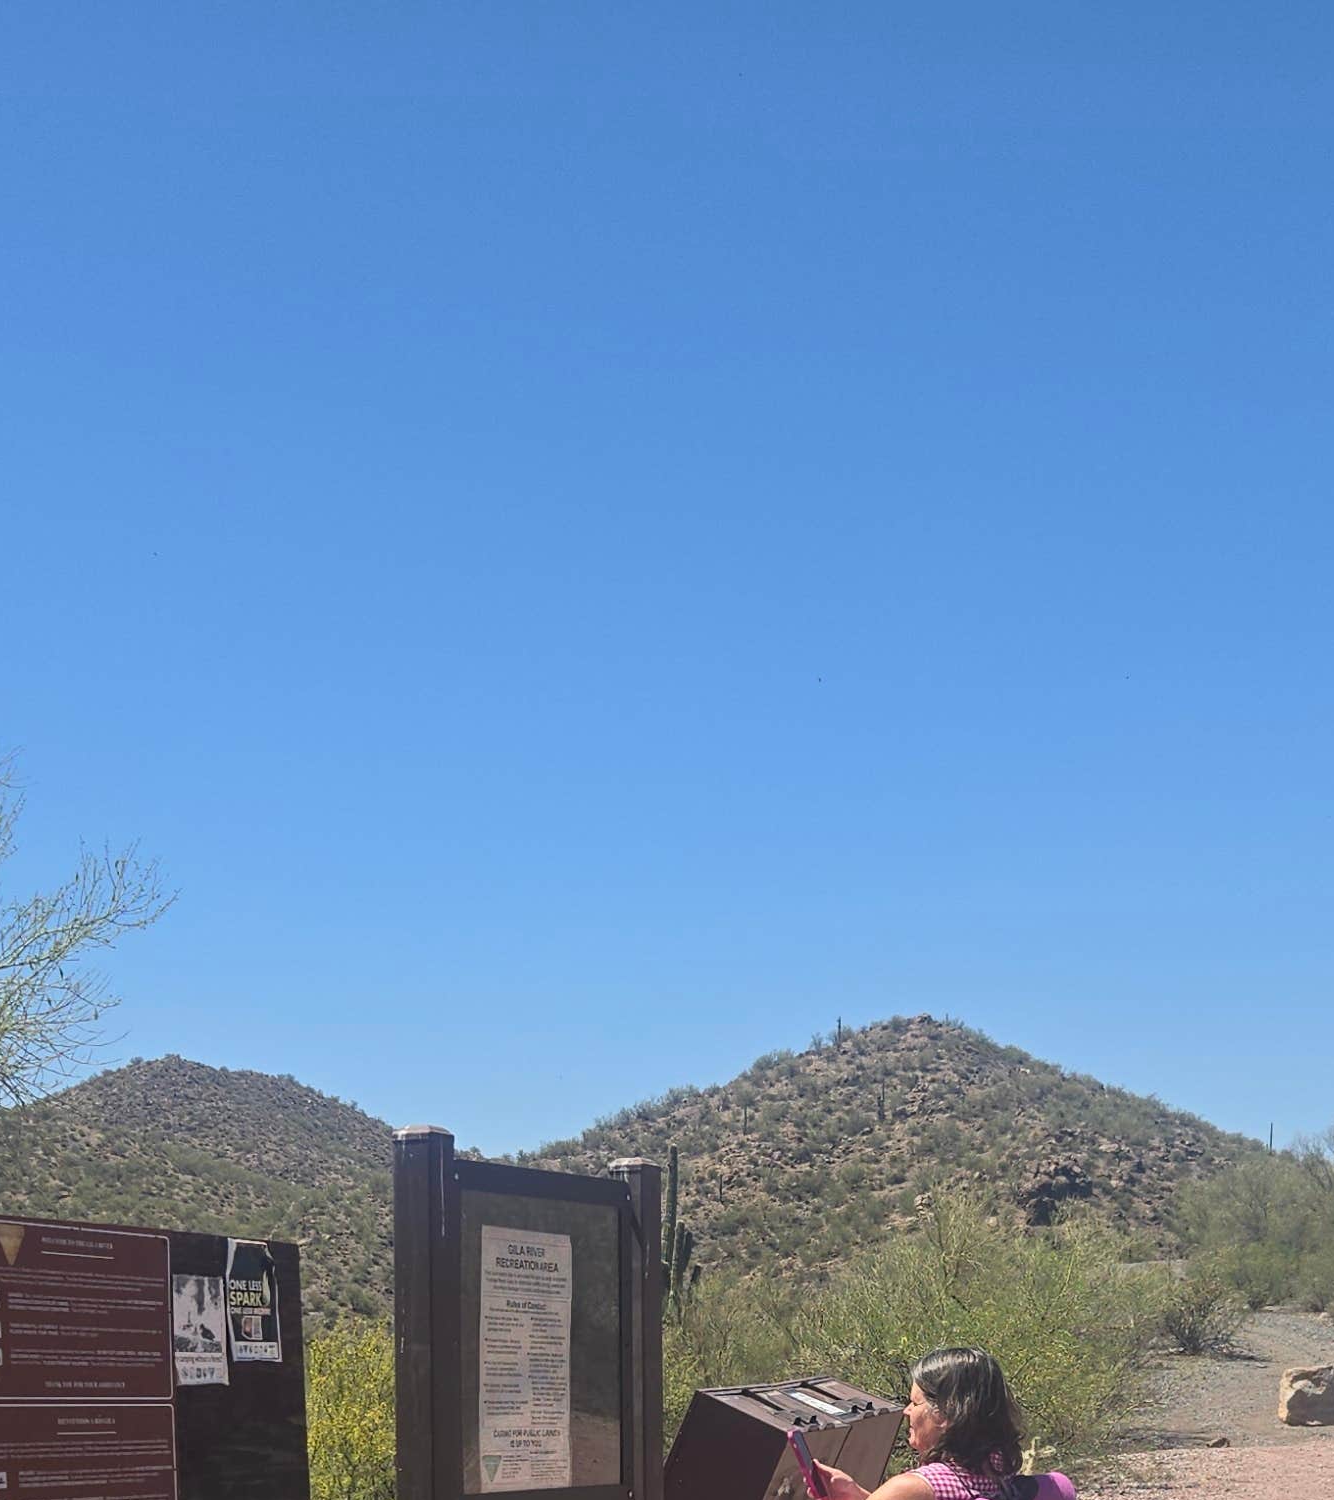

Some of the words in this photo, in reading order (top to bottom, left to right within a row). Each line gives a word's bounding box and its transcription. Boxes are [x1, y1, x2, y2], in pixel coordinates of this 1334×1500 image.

[508, 1244, 525, 1256] GILA
[526, 1246, 545, 1257] RIVER
[495, 1257, 538, 1271] RECREATION
[539, 1261, 559, 1273] AREA
[229, 1280, 247, 1290] ONE
[249, 1280, 262, 1291] LESS
[229, 1291, 263, 1306] SPARK
